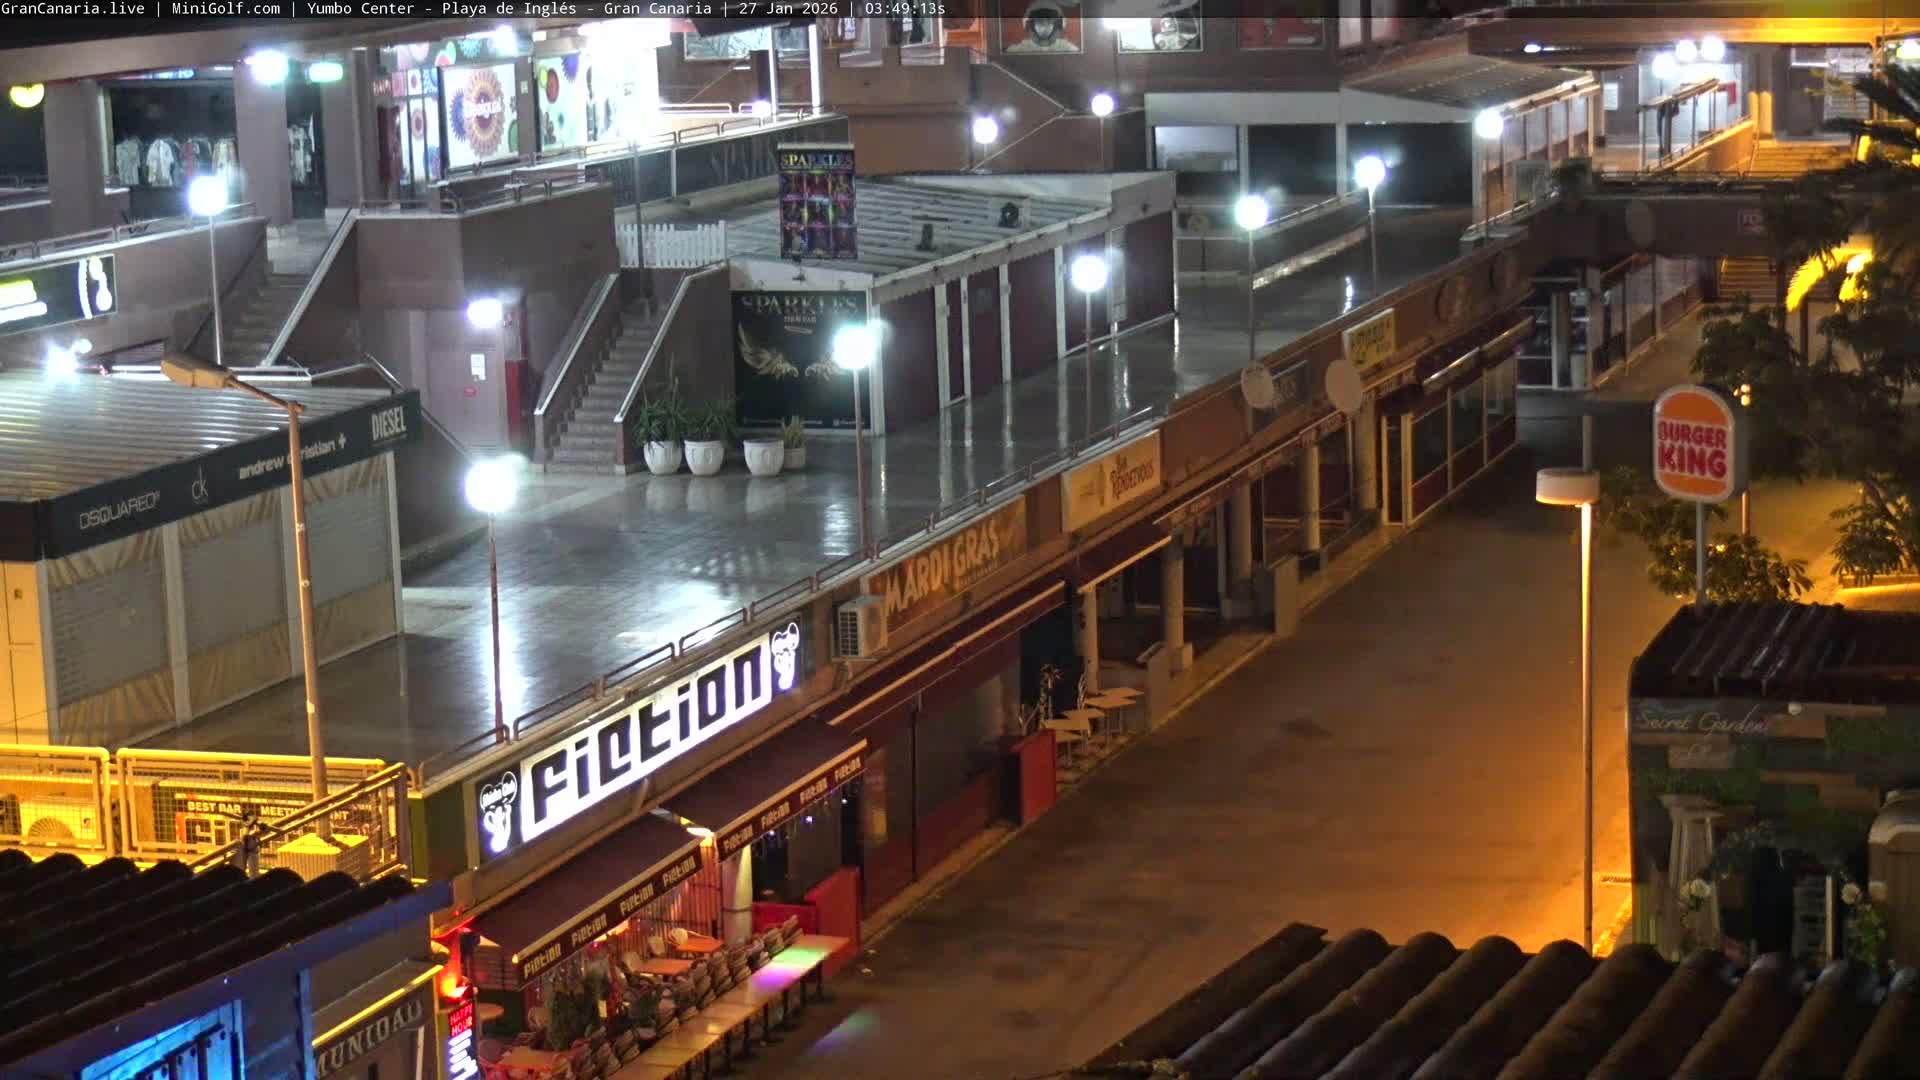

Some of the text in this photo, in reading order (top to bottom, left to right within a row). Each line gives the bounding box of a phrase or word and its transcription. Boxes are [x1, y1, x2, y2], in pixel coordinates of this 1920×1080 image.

[371, 405, 407, 440] DIESEL
[1658, 420, 1727, 450] BURGER
[239, 439, 336, 480] andrew cristian
[1658, 441, 1727, 479] KING
[886, 543, 949, 614] MARDI
[953, 518, 1001, 580] GRAS
[1636, 708, 1690, 730] Secret
[187, 801, 215, 812] BEST
[218, 803, 242, 814] BAR
[450, 1003, 473, 1025] HAPPY
[451, 1015, 473, 1036] HOUR
